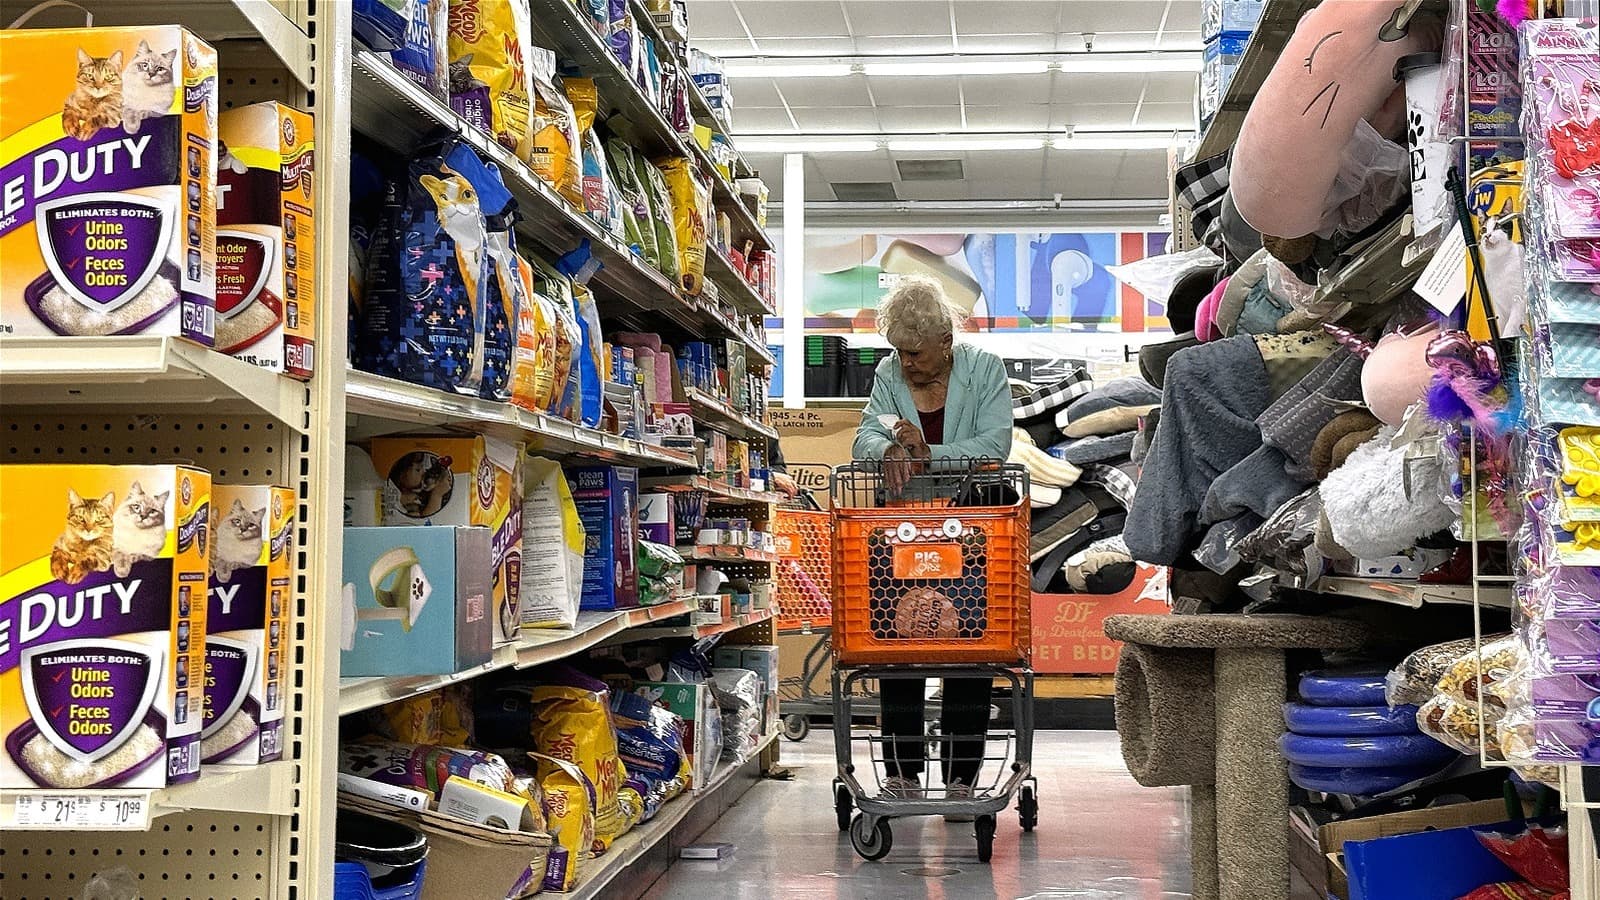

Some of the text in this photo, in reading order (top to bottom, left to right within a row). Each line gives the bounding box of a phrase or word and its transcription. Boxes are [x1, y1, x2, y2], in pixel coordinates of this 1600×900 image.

[34, 135, 152, 199] DUTY
[56, 209, 155, 220] ELIMINATES BOTH:
[85, 220, 123, 236] Urine
[85, 236, 127, 251] Odors
[226, 244, 247, 253] Odor
[85, 256, 125, 271] Feces
[84, 272, 127, 287] Odors
[223, 274, 245, 283] Fresh
[798, 411, 805, 420] 4
[807, 411, 822, 421] Pc.
[19, 579, 142, 644] DUTY
[41, 656, 142, 666] ELIMINATES BOTH:
[71, 667, 110, 682] Urine
[71, 684, 114, 698] Odors
[69, 704, 110, 719] Feces
[69, 720, 113, 735] Odors
